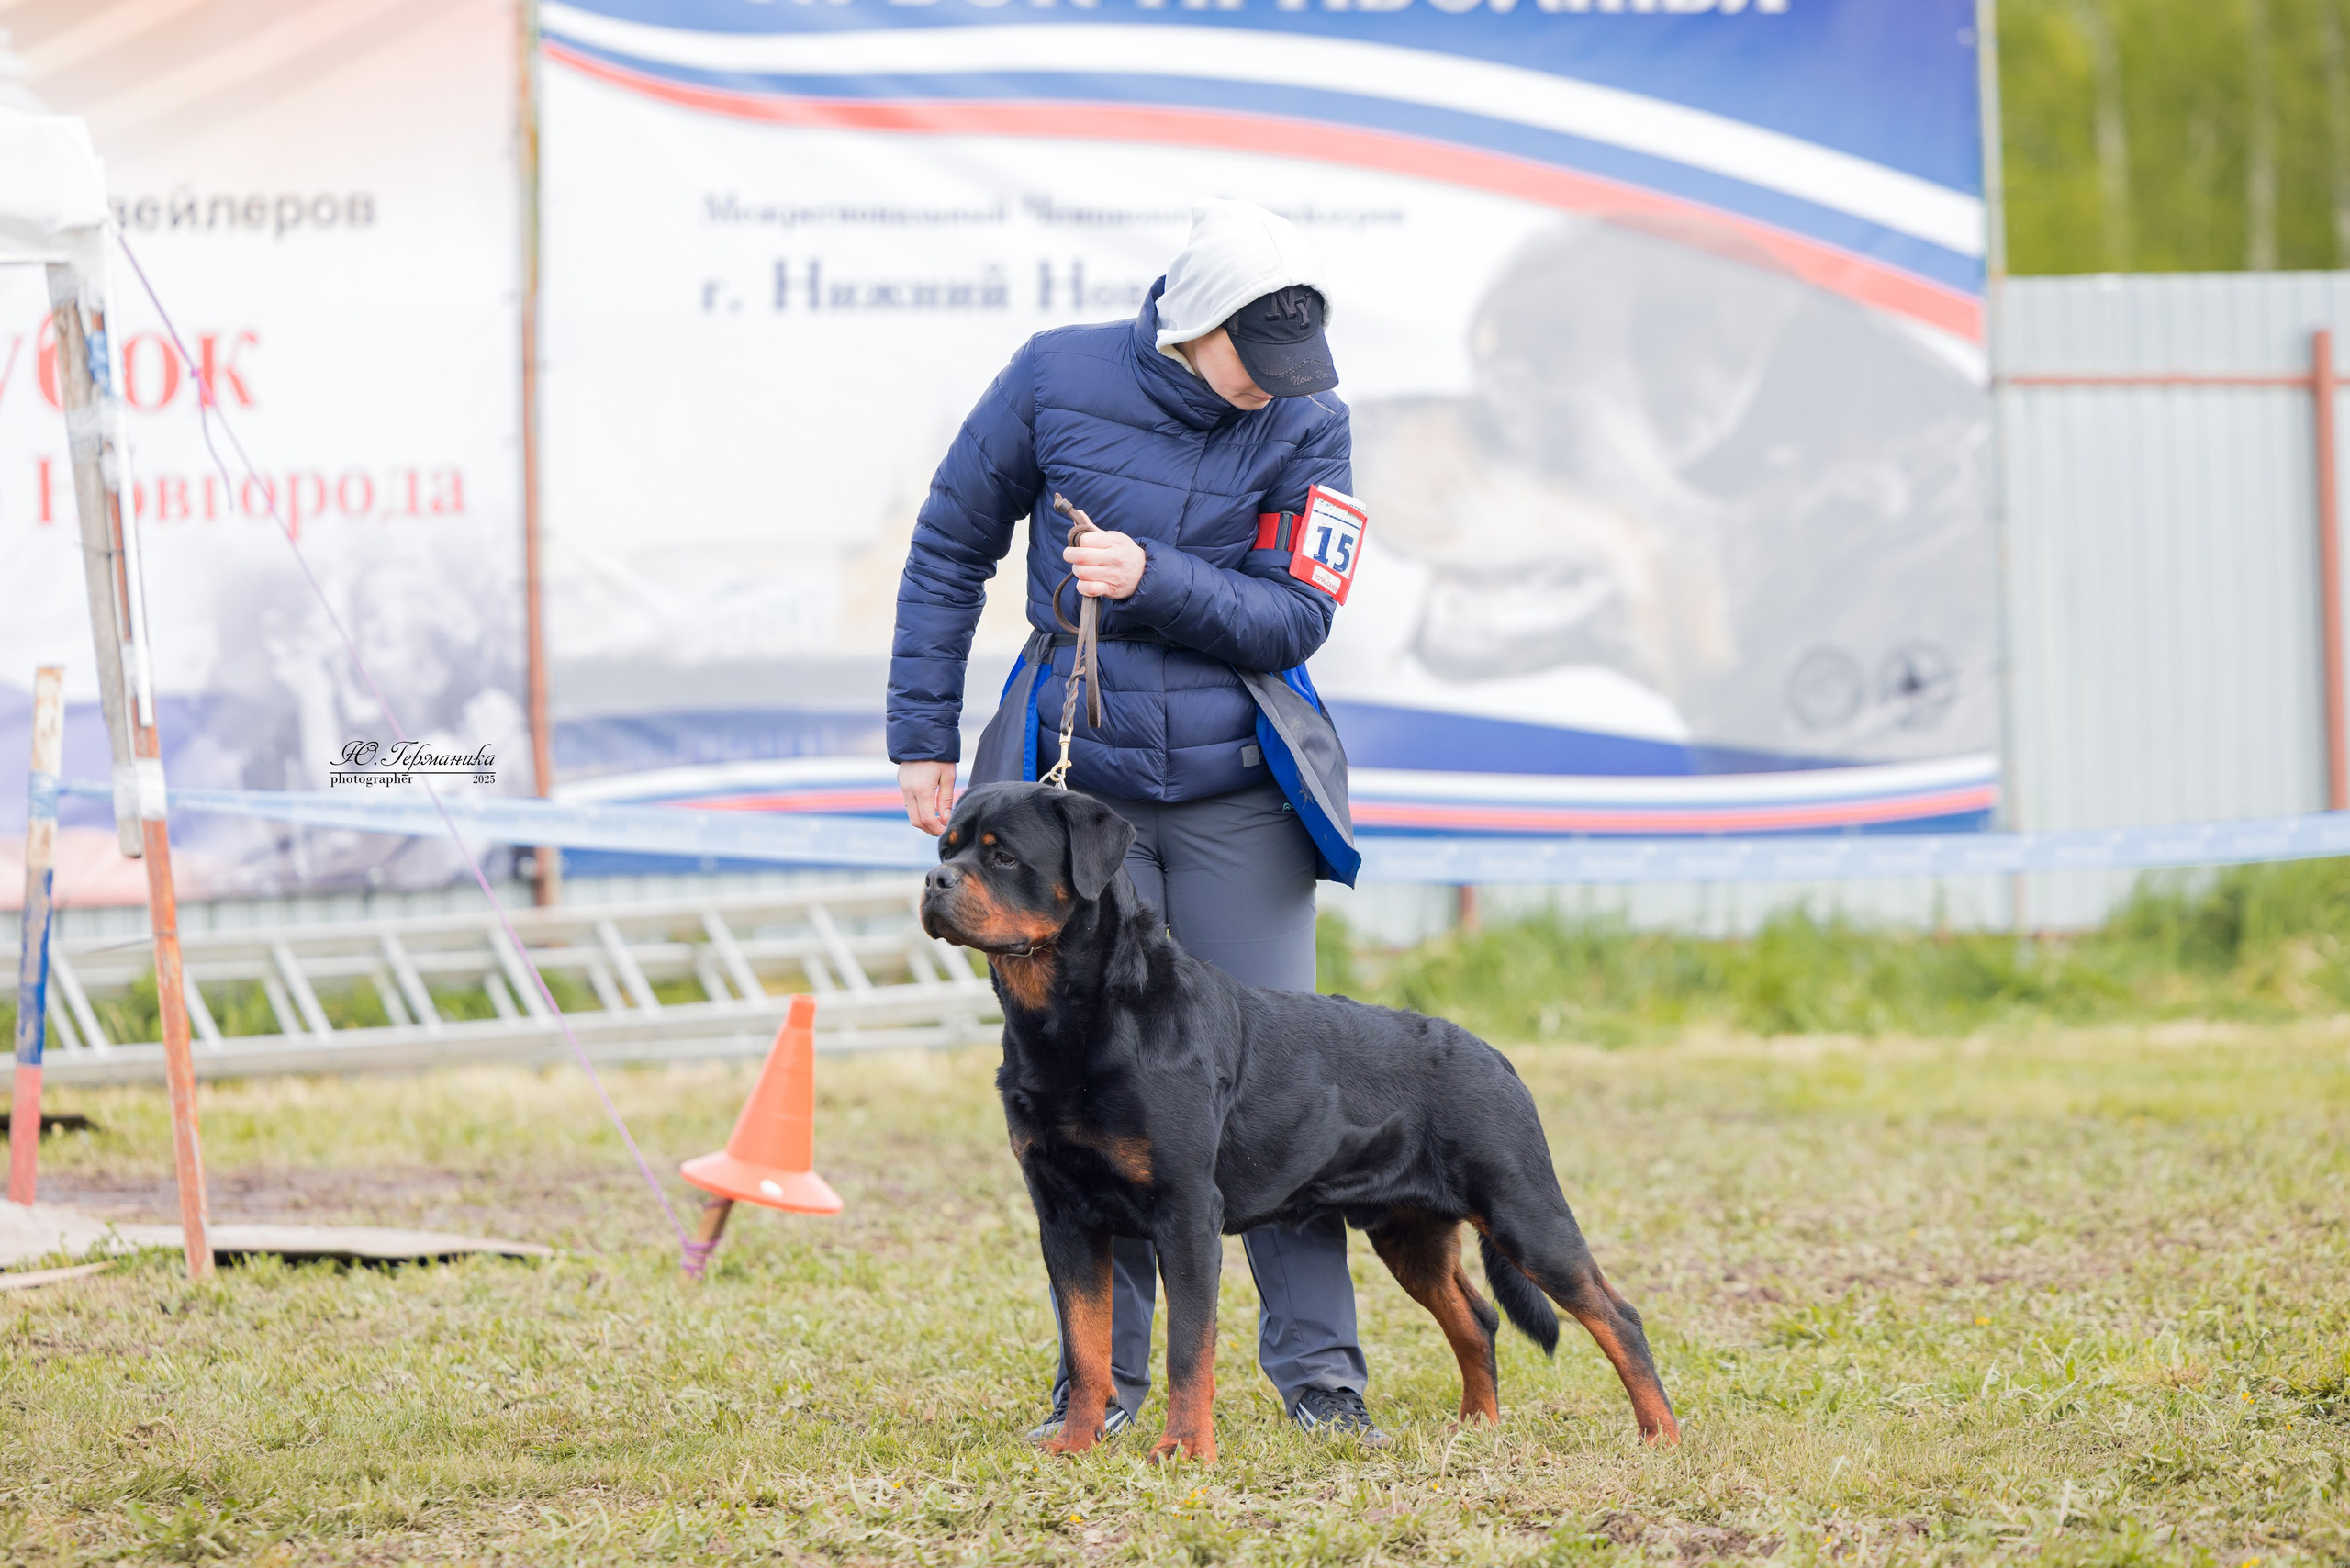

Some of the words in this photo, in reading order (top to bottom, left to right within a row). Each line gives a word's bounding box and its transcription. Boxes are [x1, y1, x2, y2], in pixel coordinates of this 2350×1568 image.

[773, 260, 1007, 312] Нижний
[1265, 287, 1314, 330] NY
[1289, 375, 1313, 386] New
[35, 456, 466, 542] Нвгорода
[1313, 525, 1354, 573] 15
